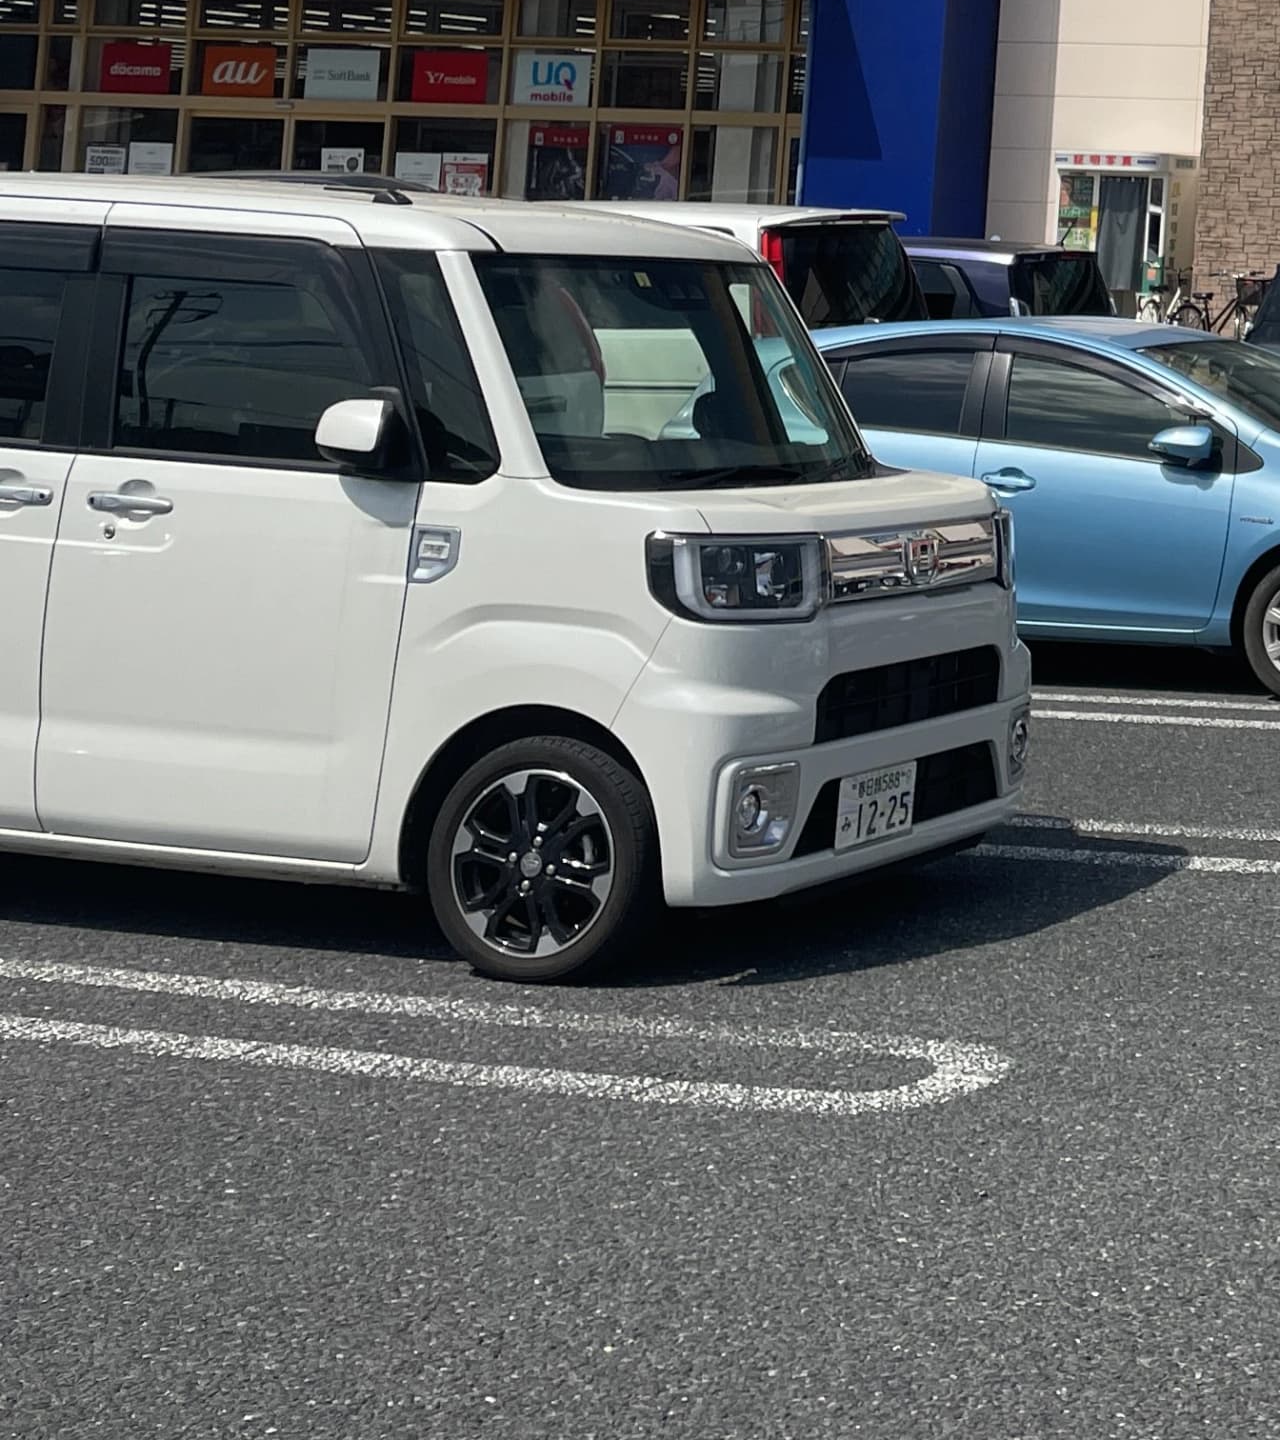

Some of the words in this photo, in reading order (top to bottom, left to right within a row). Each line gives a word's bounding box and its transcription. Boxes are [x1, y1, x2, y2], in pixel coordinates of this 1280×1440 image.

[212, 59, 270, 86] au
[327, 69, 372, 82] SoftBank
[531, 60, 577, 91] UQ
[530, 91, 574, 103] mobile
[856, 791, 911, 839] 12-25
